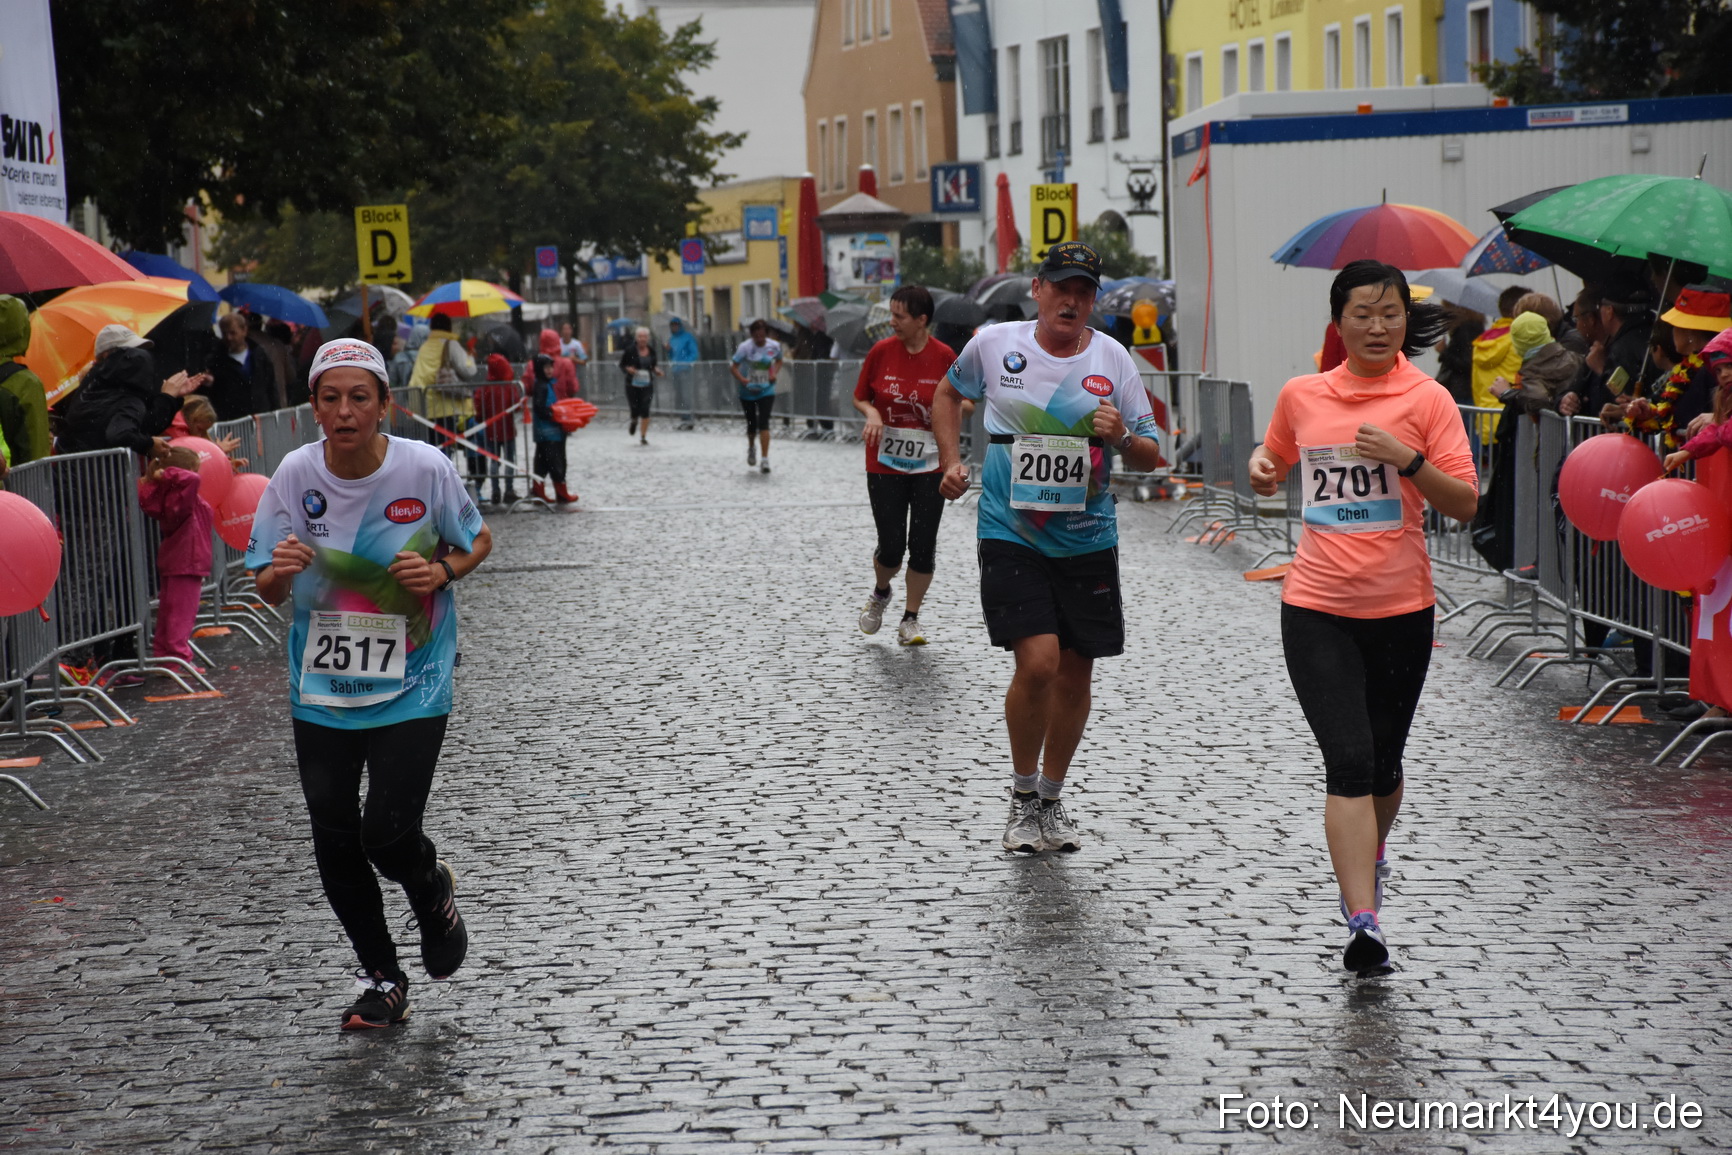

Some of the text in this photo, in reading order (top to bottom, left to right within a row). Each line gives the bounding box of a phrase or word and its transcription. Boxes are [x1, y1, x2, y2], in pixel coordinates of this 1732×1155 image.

[937, 169, 976, 203] KL
[1036, 187, 1073, 201] Block
[361, 209, 402, 224] Block
[1043, 208, 1066, 245] D
[371, 230, 397, 267] D
[1000, 375, 1025, 386] PARTL
[1000, 382, 1024, 391] Neumarkt
[884, 438, 925, 458] 2797
[1020, 453, 1084, 483] 2084
[1313, 463, 1388, 502] 2701
[1038, 489, 1061, 504] Jörg
[390, 504, 422, 518] Hervis
[1337, 508, 1369, 521] Chen
[1645, 514, 1709, 543] RÖDL
[347, 615, 397, 630] BOCK
[314, 634, 397, 673] 2517
[330, 679, 373, 694] Sabine
